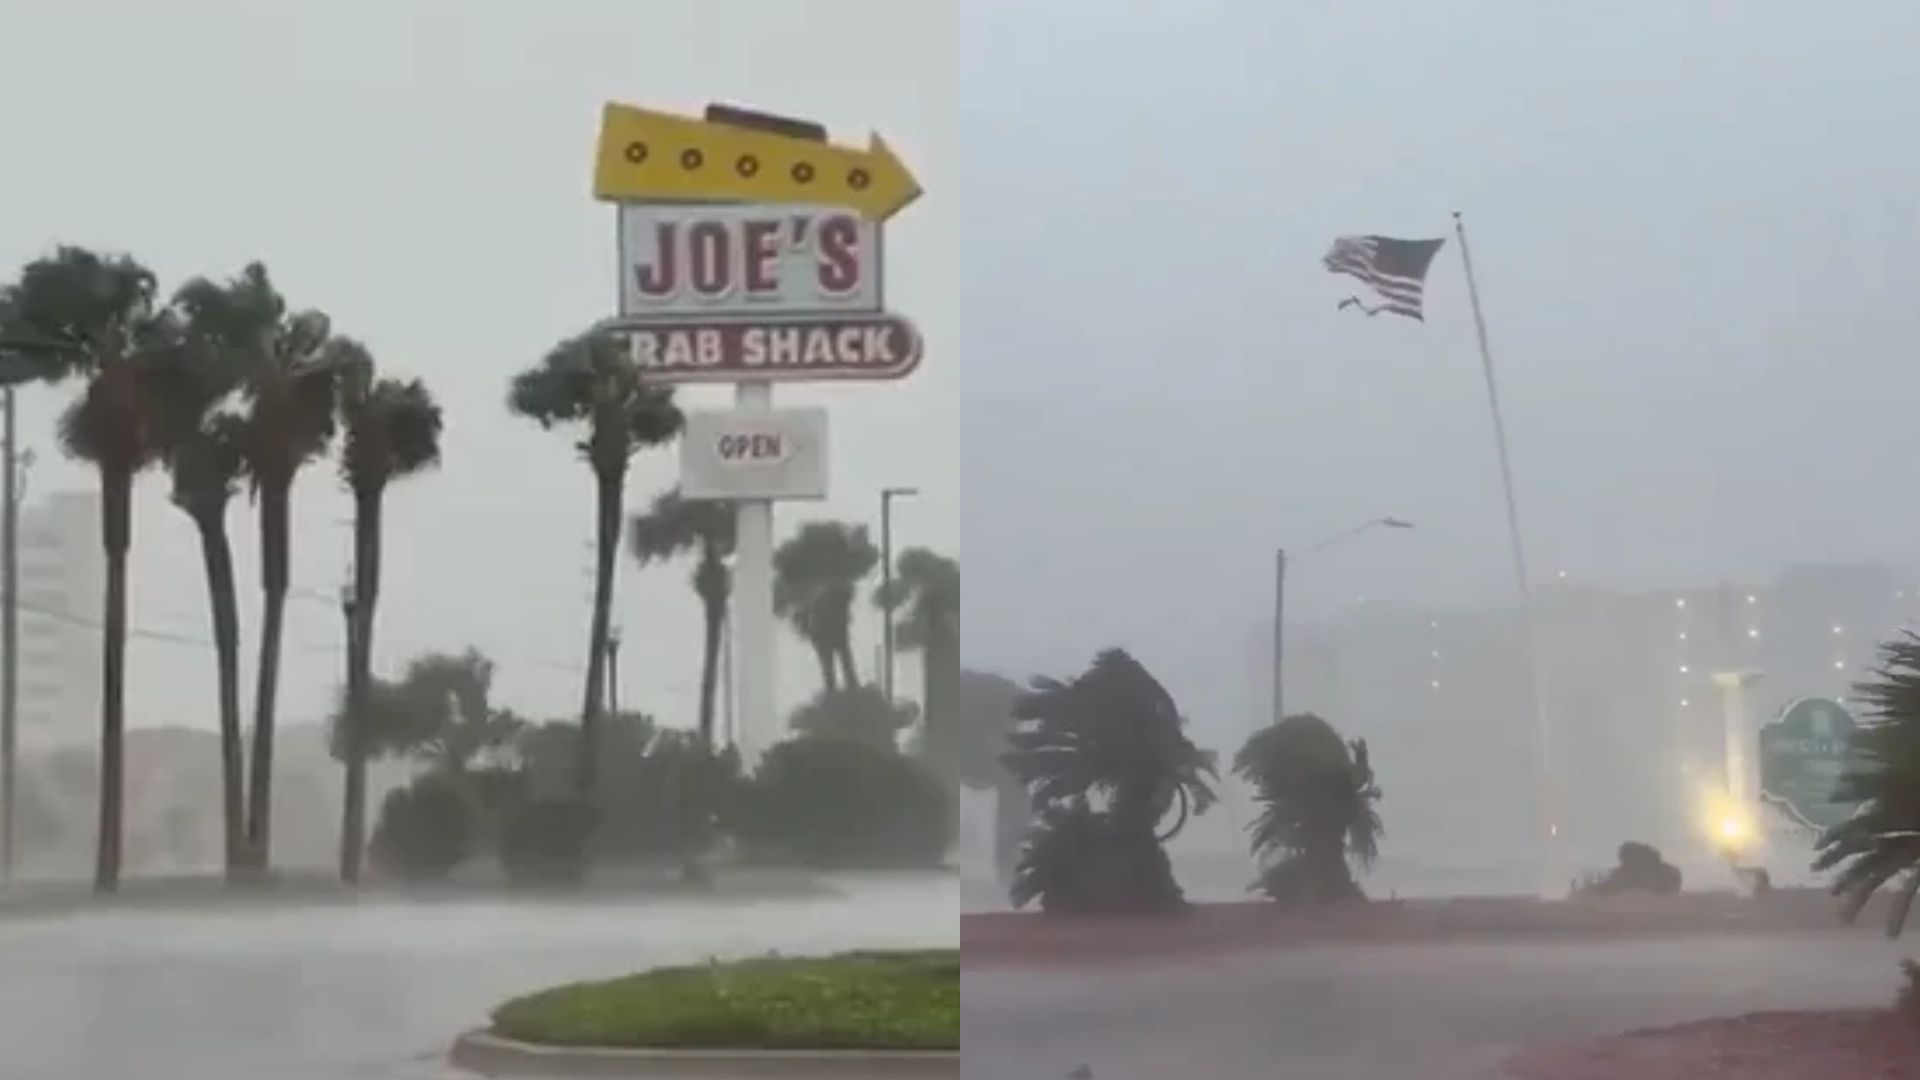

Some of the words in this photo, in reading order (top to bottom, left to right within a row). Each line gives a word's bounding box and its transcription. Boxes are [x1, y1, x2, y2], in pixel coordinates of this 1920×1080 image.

[633, 214, 860, 296] JOE'S
[613, 328, 723, 367] RAB
[741, 327, 893, 366] SHACK
[718, 433, 782, 461] OPEN
